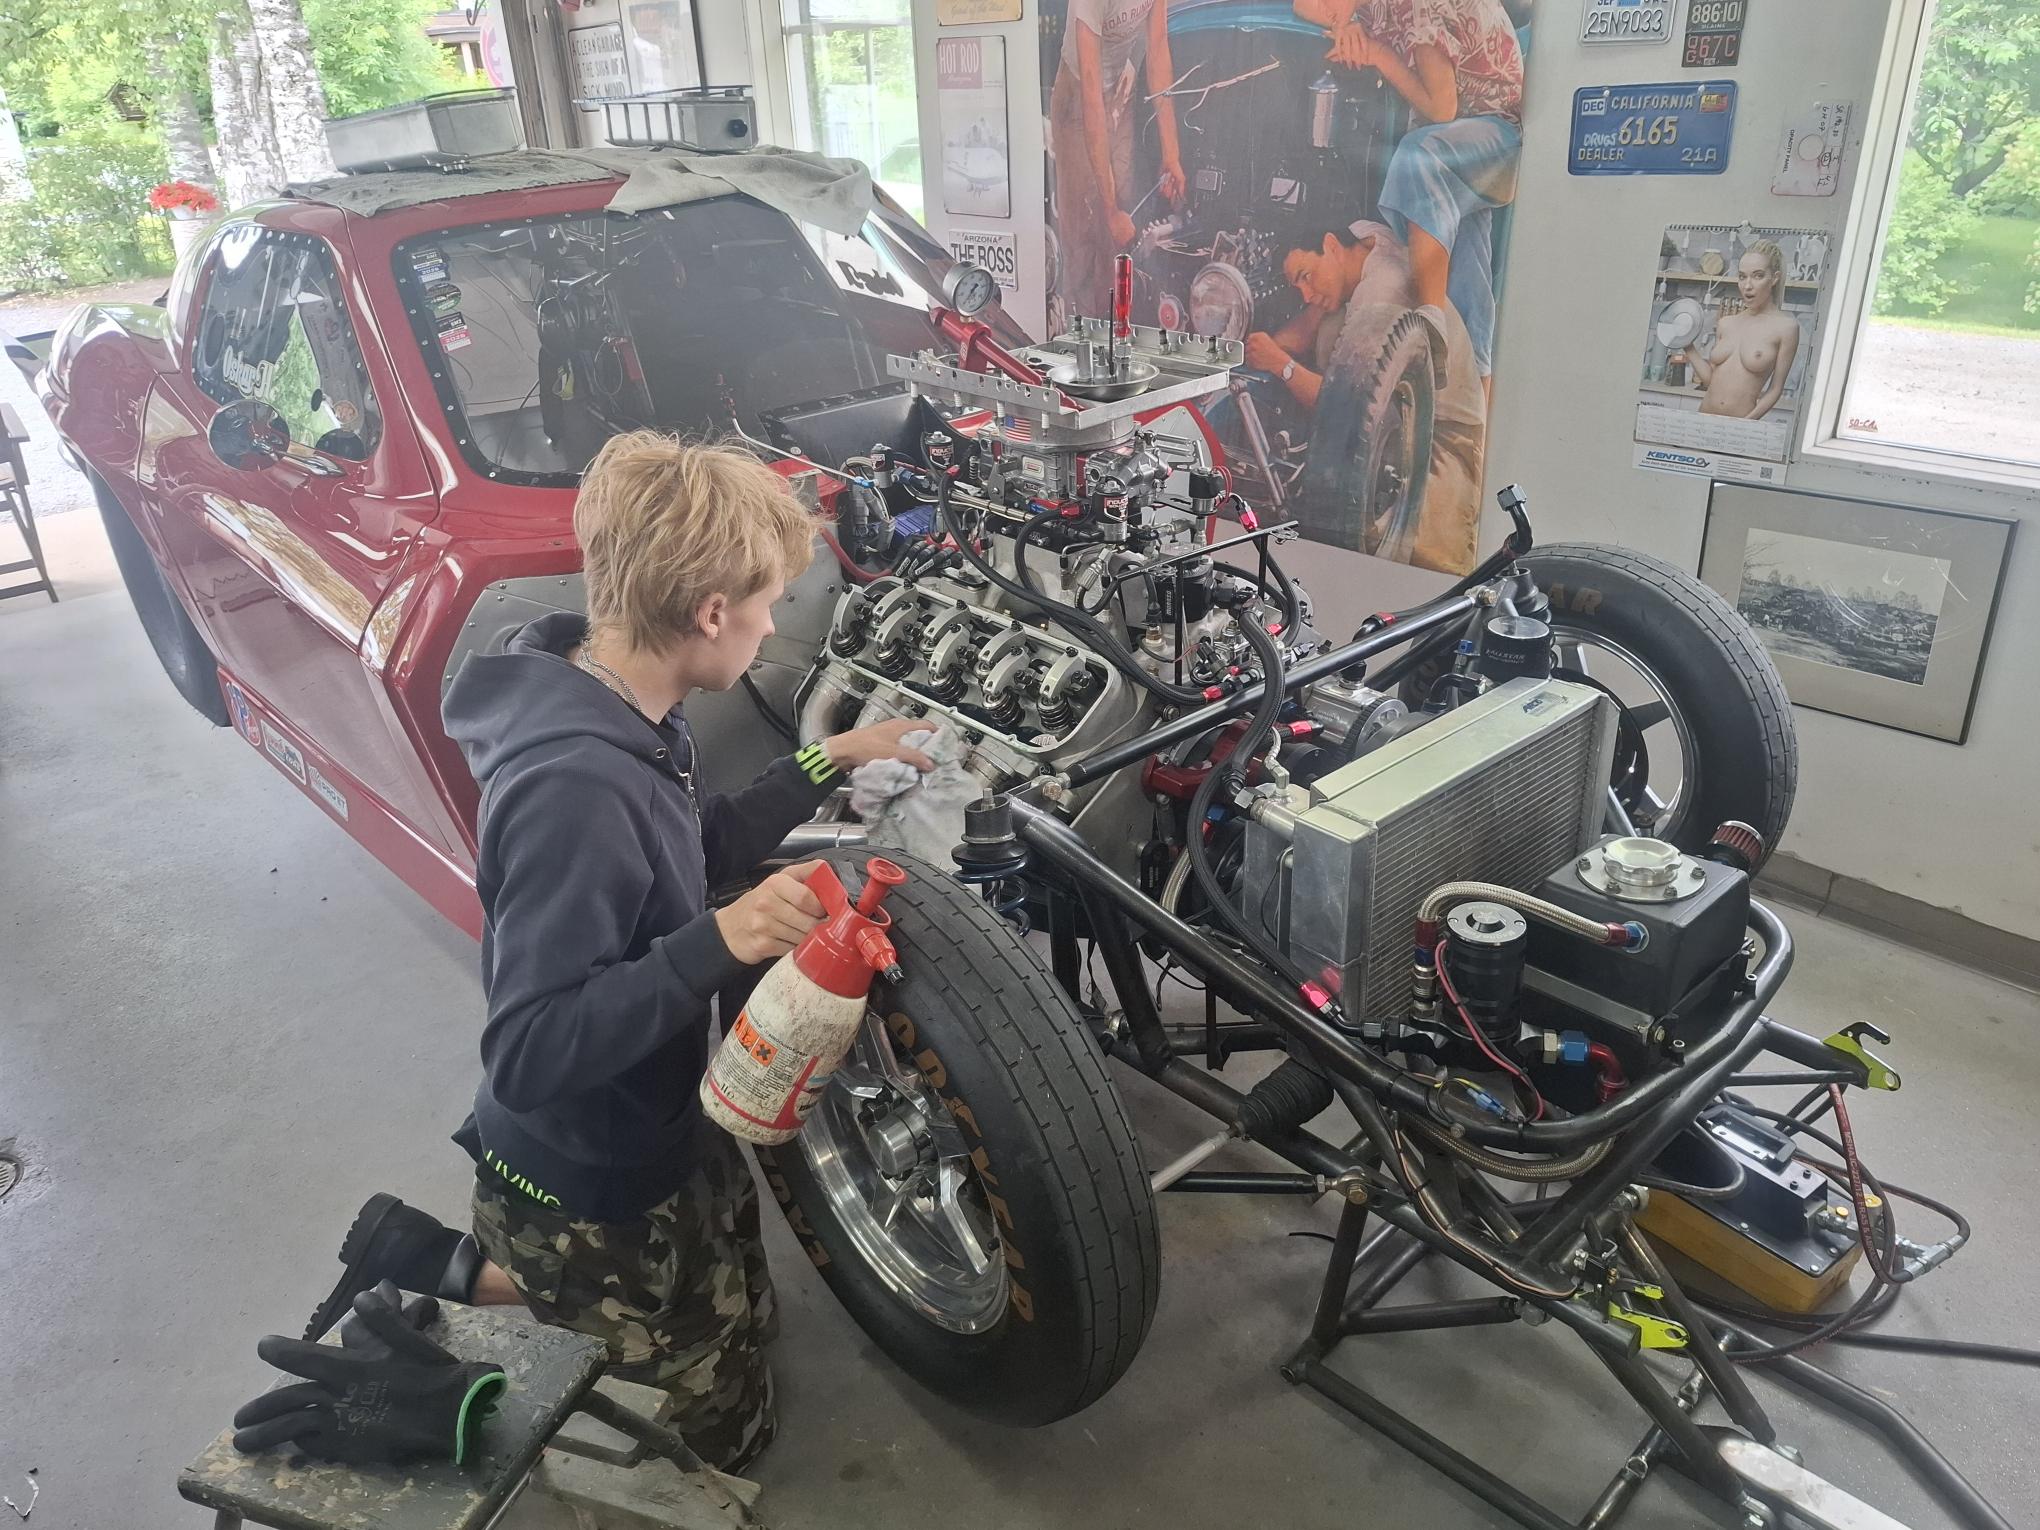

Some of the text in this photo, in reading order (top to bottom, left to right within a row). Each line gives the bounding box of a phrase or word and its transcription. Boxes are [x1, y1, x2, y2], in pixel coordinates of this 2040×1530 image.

[1587, 9, 1663, 35] 25N9033
[939, 43, 980, 74] HOT ROD
[1583, 100, 1605, 113] DEC
[1611, 93, 1694, 111] CALIFORNIA
[1583, 132, 1618, 147] DRUGS
[1618, 116, 1679, 146] 6165
[1578, 147, 1717, 163] DEALER 21A
[964, 235, 998, 244] ARIZONA
[951, 243, 1014, 274] THE BOSS
[1647, 450, 1696, 464] KENTSO
[1695, 457, 1711, 468] Oy
[1845, 1131, 1856, 1158] MSHA
[1857, 1201, 1870, 1225] FRAS
